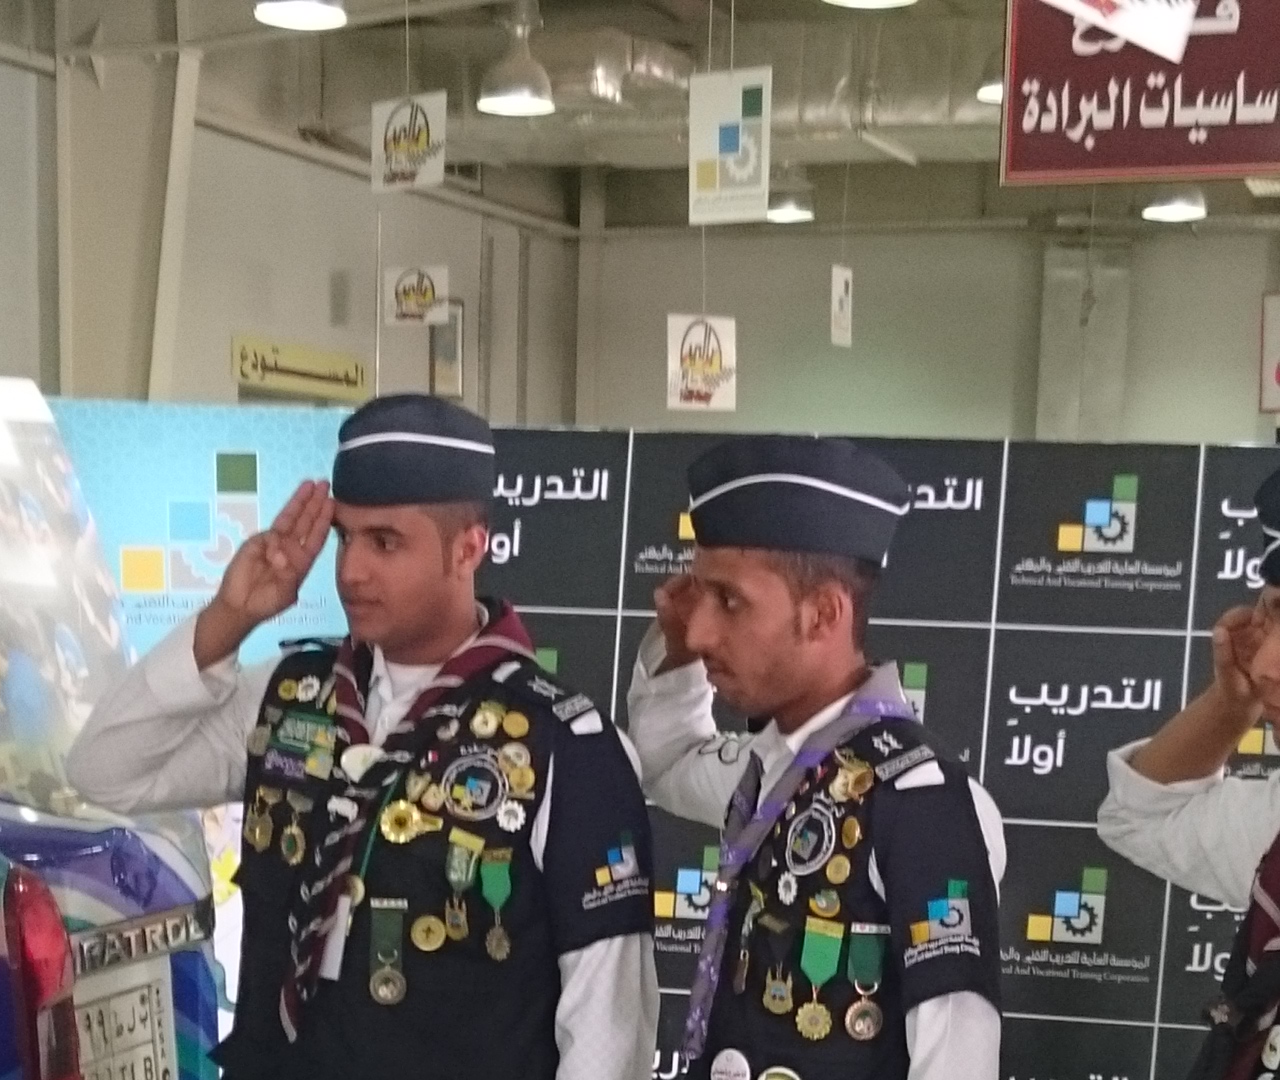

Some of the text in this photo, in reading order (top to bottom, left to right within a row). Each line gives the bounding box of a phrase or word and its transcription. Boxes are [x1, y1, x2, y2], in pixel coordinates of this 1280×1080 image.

[1021, 71, 1131, 151] البرادة
[238, 344, 365, 389] المستودع
[1008, 678, 1162, 720] التدريب
[1004, 717, 1066, 776] أولاً
[72, 911, 206, 974] PATROL
